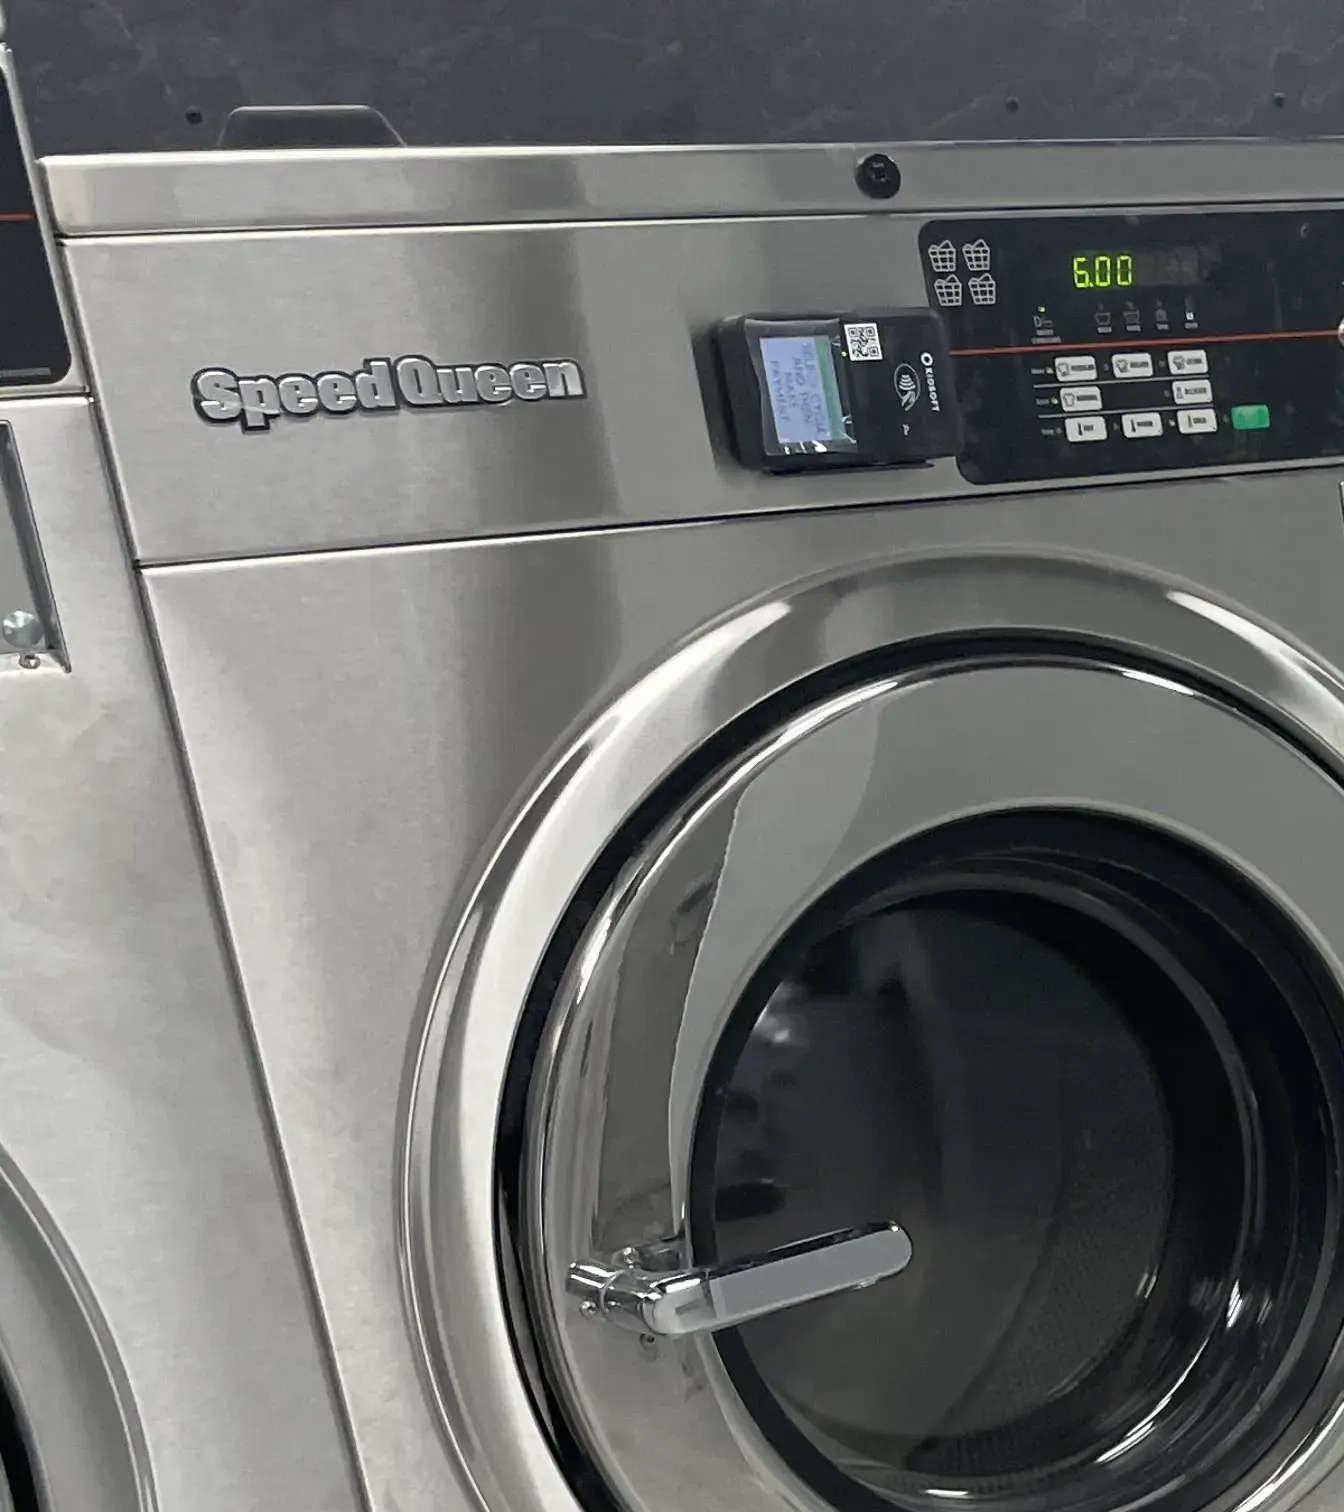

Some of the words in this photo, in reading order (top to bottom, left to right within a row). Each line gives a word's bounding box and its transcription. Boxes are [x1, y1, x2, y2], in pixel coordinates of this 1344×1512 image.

[1073, 255, 1132, 288] 6.00
[193, 356, 397, 432] Speed
[395, 353, 587, 408] Queen
